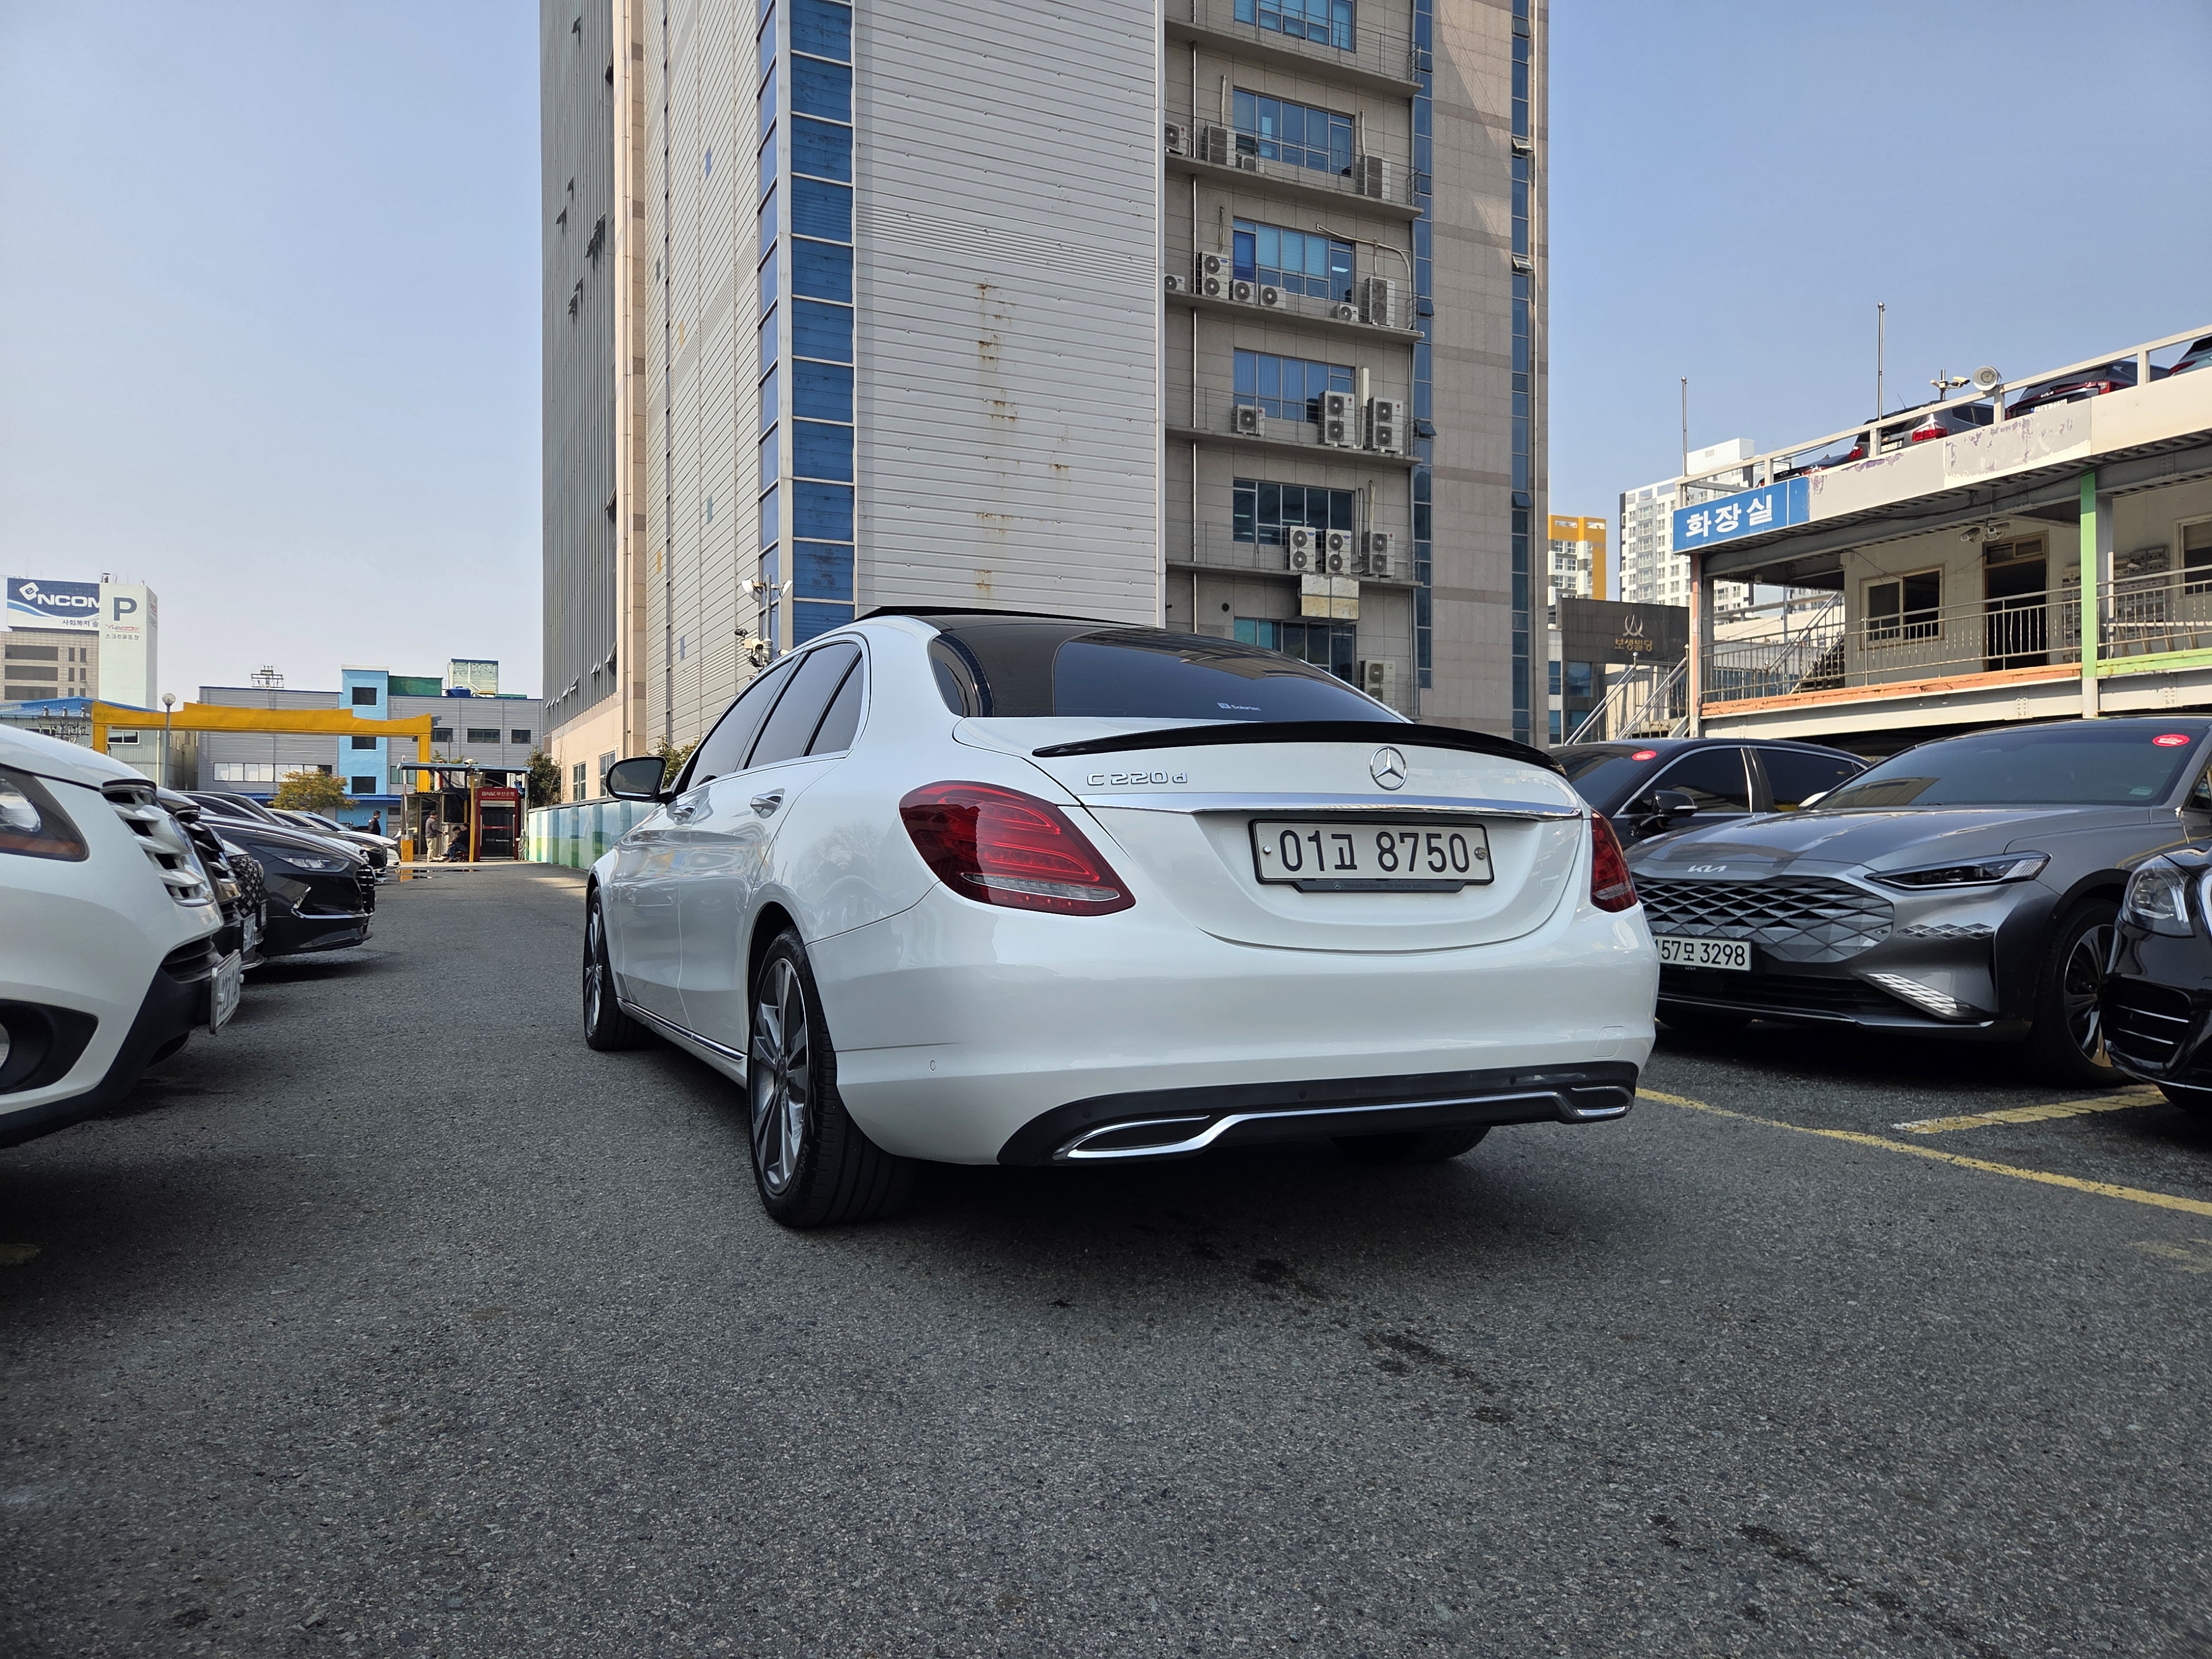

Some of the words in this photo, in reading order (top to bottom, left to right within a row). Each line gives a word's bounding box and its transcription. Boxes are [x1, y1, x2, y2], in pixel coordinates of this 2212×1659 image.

[1686, 494, 1772, 538] 화장실
[113, 597, 137, 621] P
[1615, 638, 1652, 652] 보생빌딩
[1087, 773, 1104, 786] C
[1279, 830, 1358, 872] 01고
[1375, 831, 1470, 873] 8750
[1700, 942, 1745, 967] 3298
